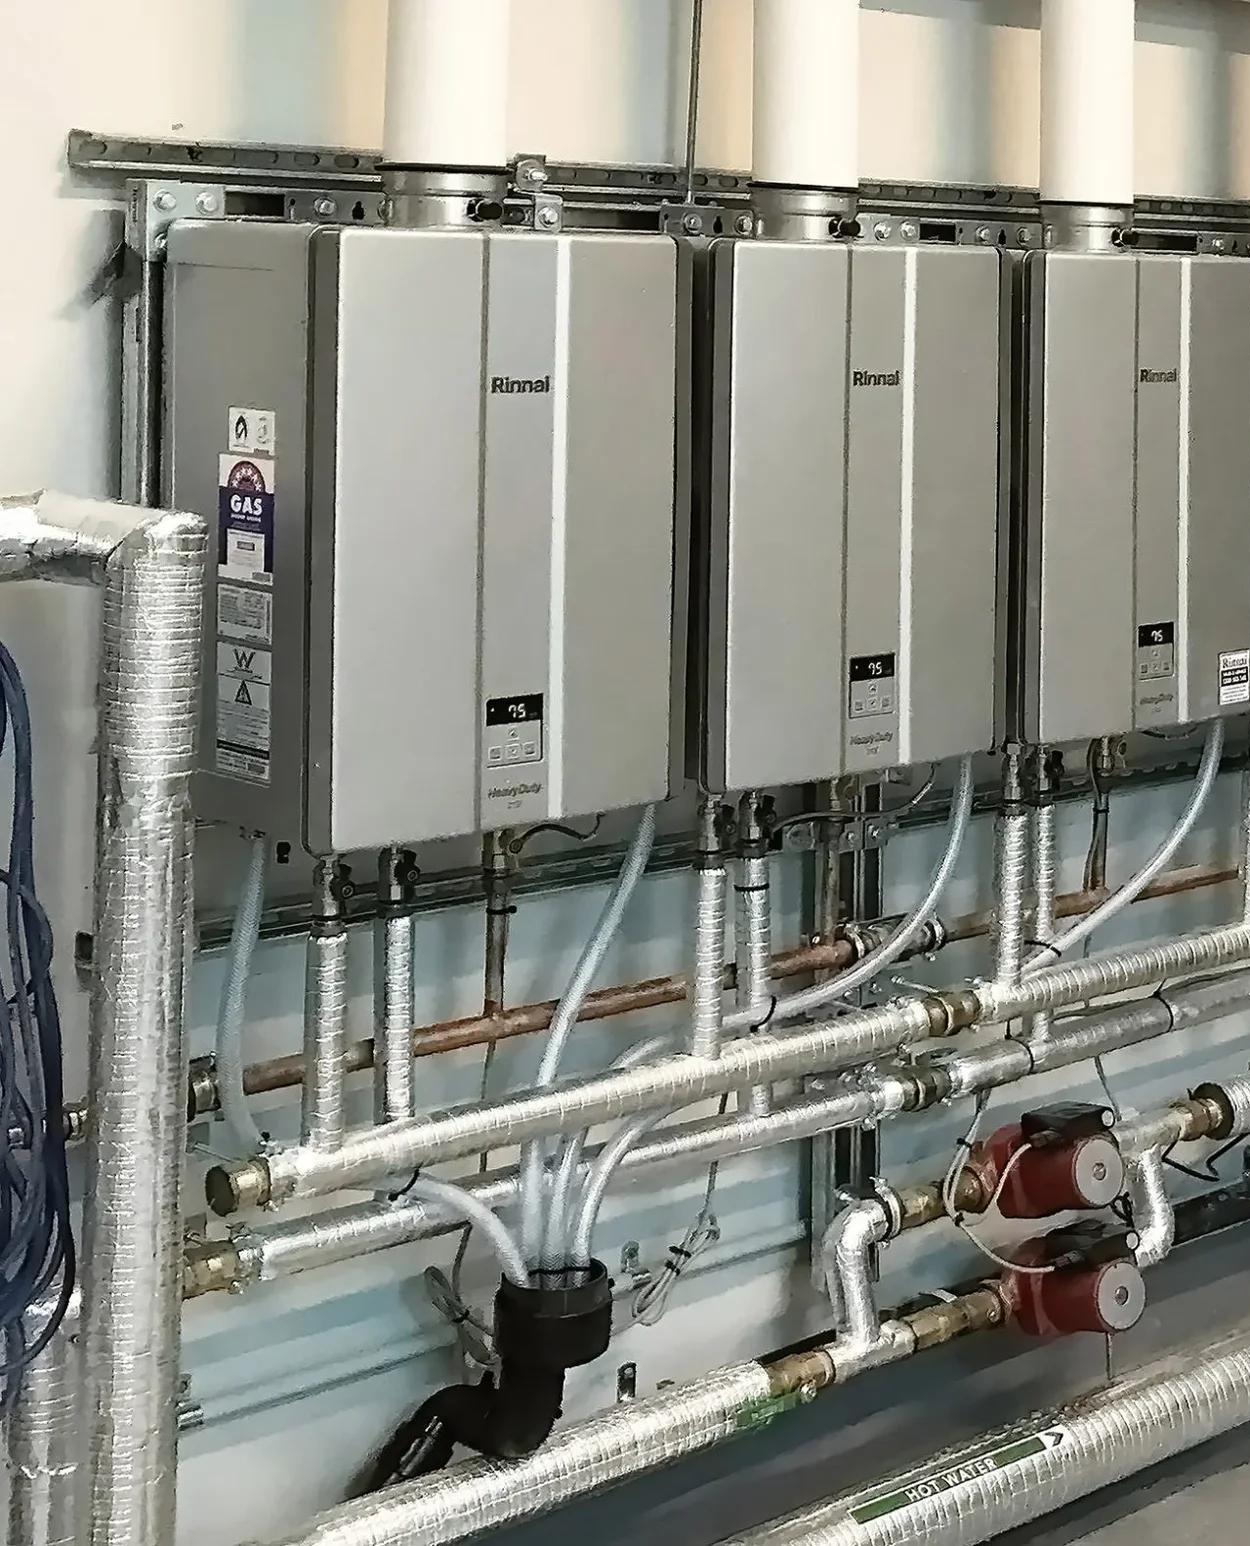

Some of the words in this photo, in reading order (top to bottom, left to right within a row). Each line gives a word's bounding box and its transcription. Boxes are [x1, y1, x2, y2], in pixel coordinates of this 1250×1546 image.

[490, 375, 550, 393] Rinnai
[852, 370, 900, 386] Rinnai
[230, 494, 263, 516] GAS
[1151, 629, 1163, 642] 75
[868, 662, 883, 675] 75
[508, 703, 526, 718] 75
[904, 1480, 940, 1502] HOT
[943, 1457, 998, 1487] WATER
